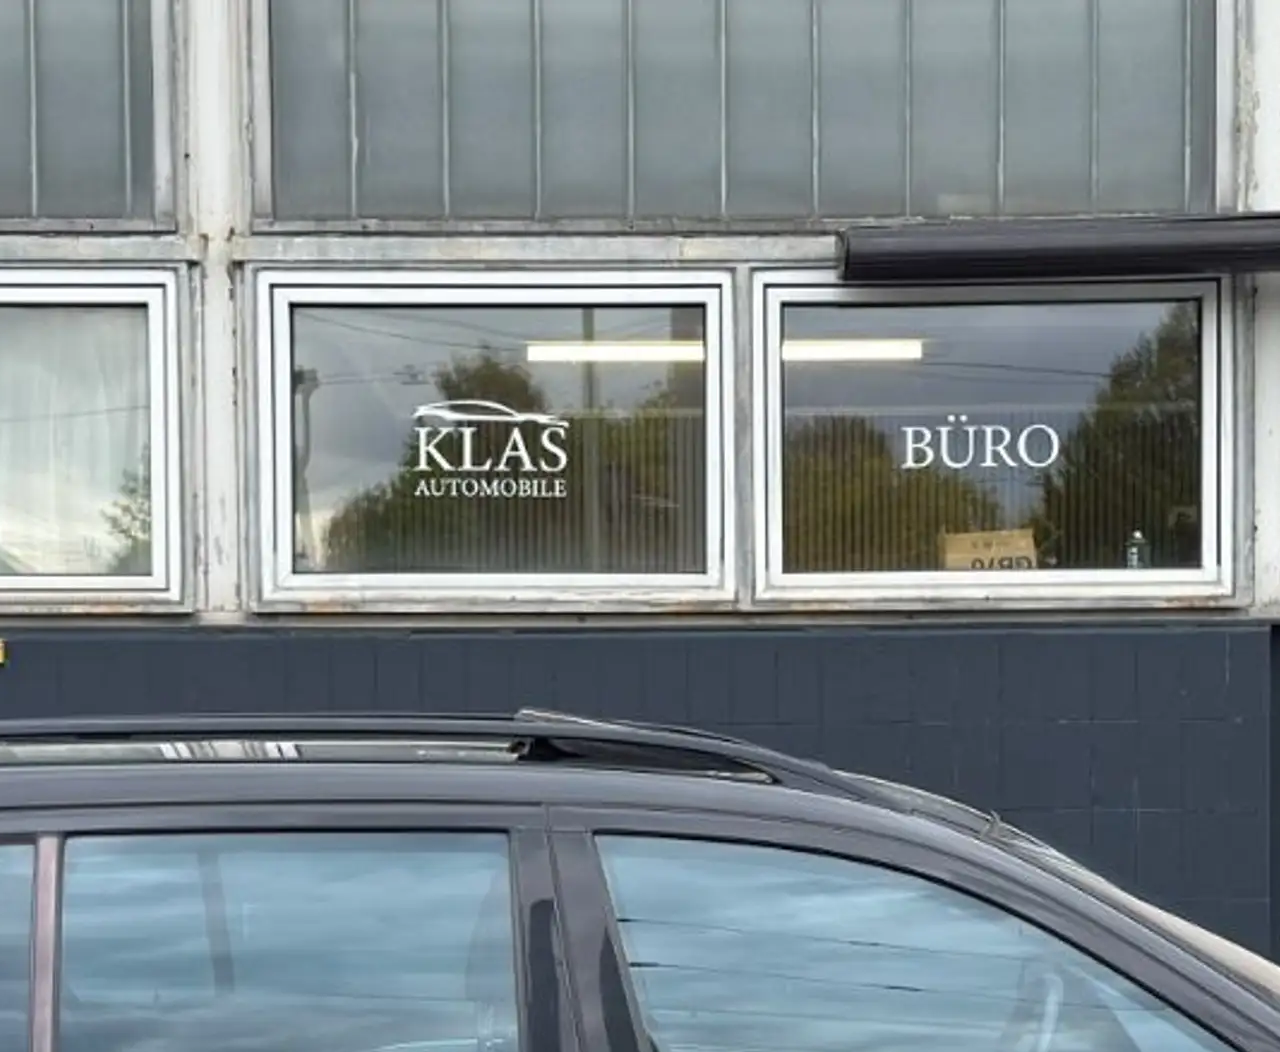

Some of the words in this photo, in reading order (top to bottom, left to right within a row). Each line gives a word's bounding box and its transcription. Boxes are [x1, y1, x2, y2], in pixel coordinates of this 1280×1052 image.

[413, 426, 568, 472] KLAS
[901, 414, 1060, 469] BÜRO
[414, 478, 567, 498] AUTOMOBILE
